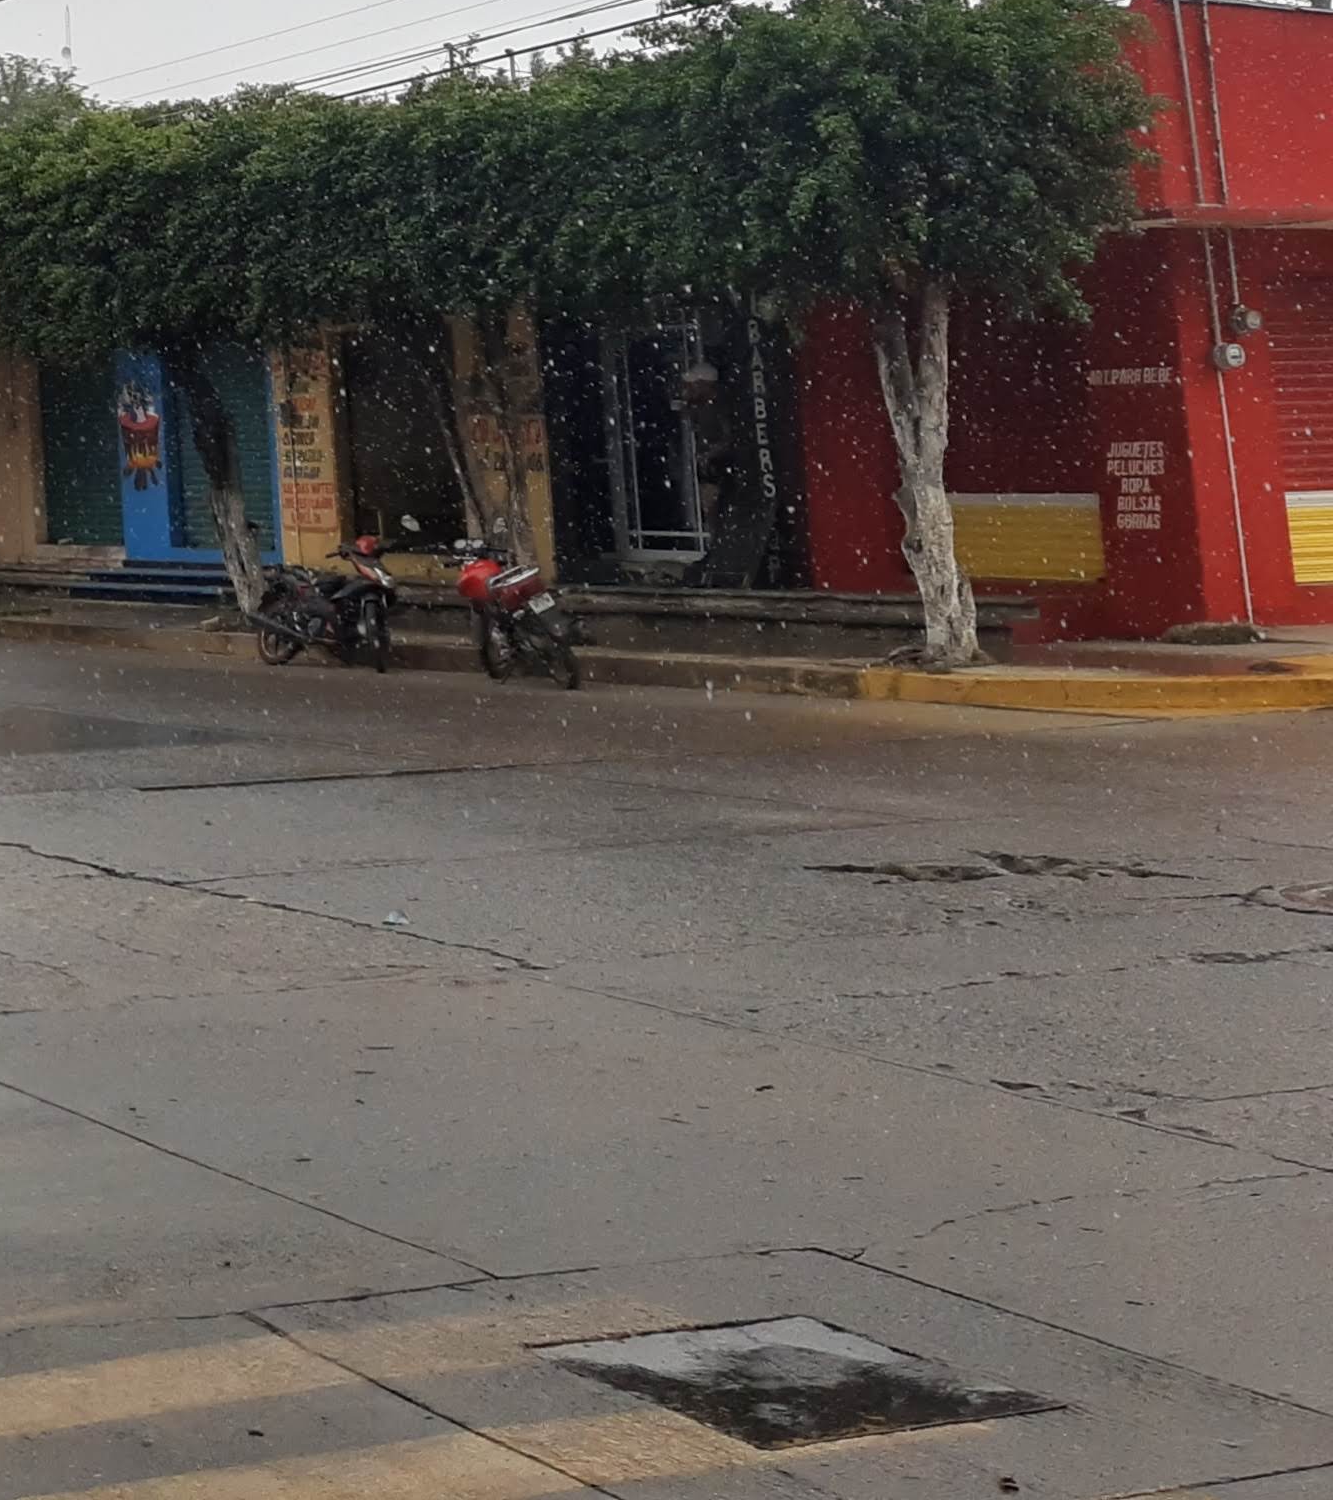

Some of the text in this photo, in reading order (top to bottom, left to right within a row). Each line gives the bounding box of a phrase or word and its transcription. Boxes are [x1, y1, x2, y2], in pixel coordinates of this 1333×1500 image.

[1107, 441, 1164, 458] JUGUETES
[1107, 460, 1165, 476] PELUCHES
[1121, 477, 1152, 494] ROPA
[1117, 495, 1162, 512] BOLSAS
[1116, 513, 1161, 530] GORRAS
